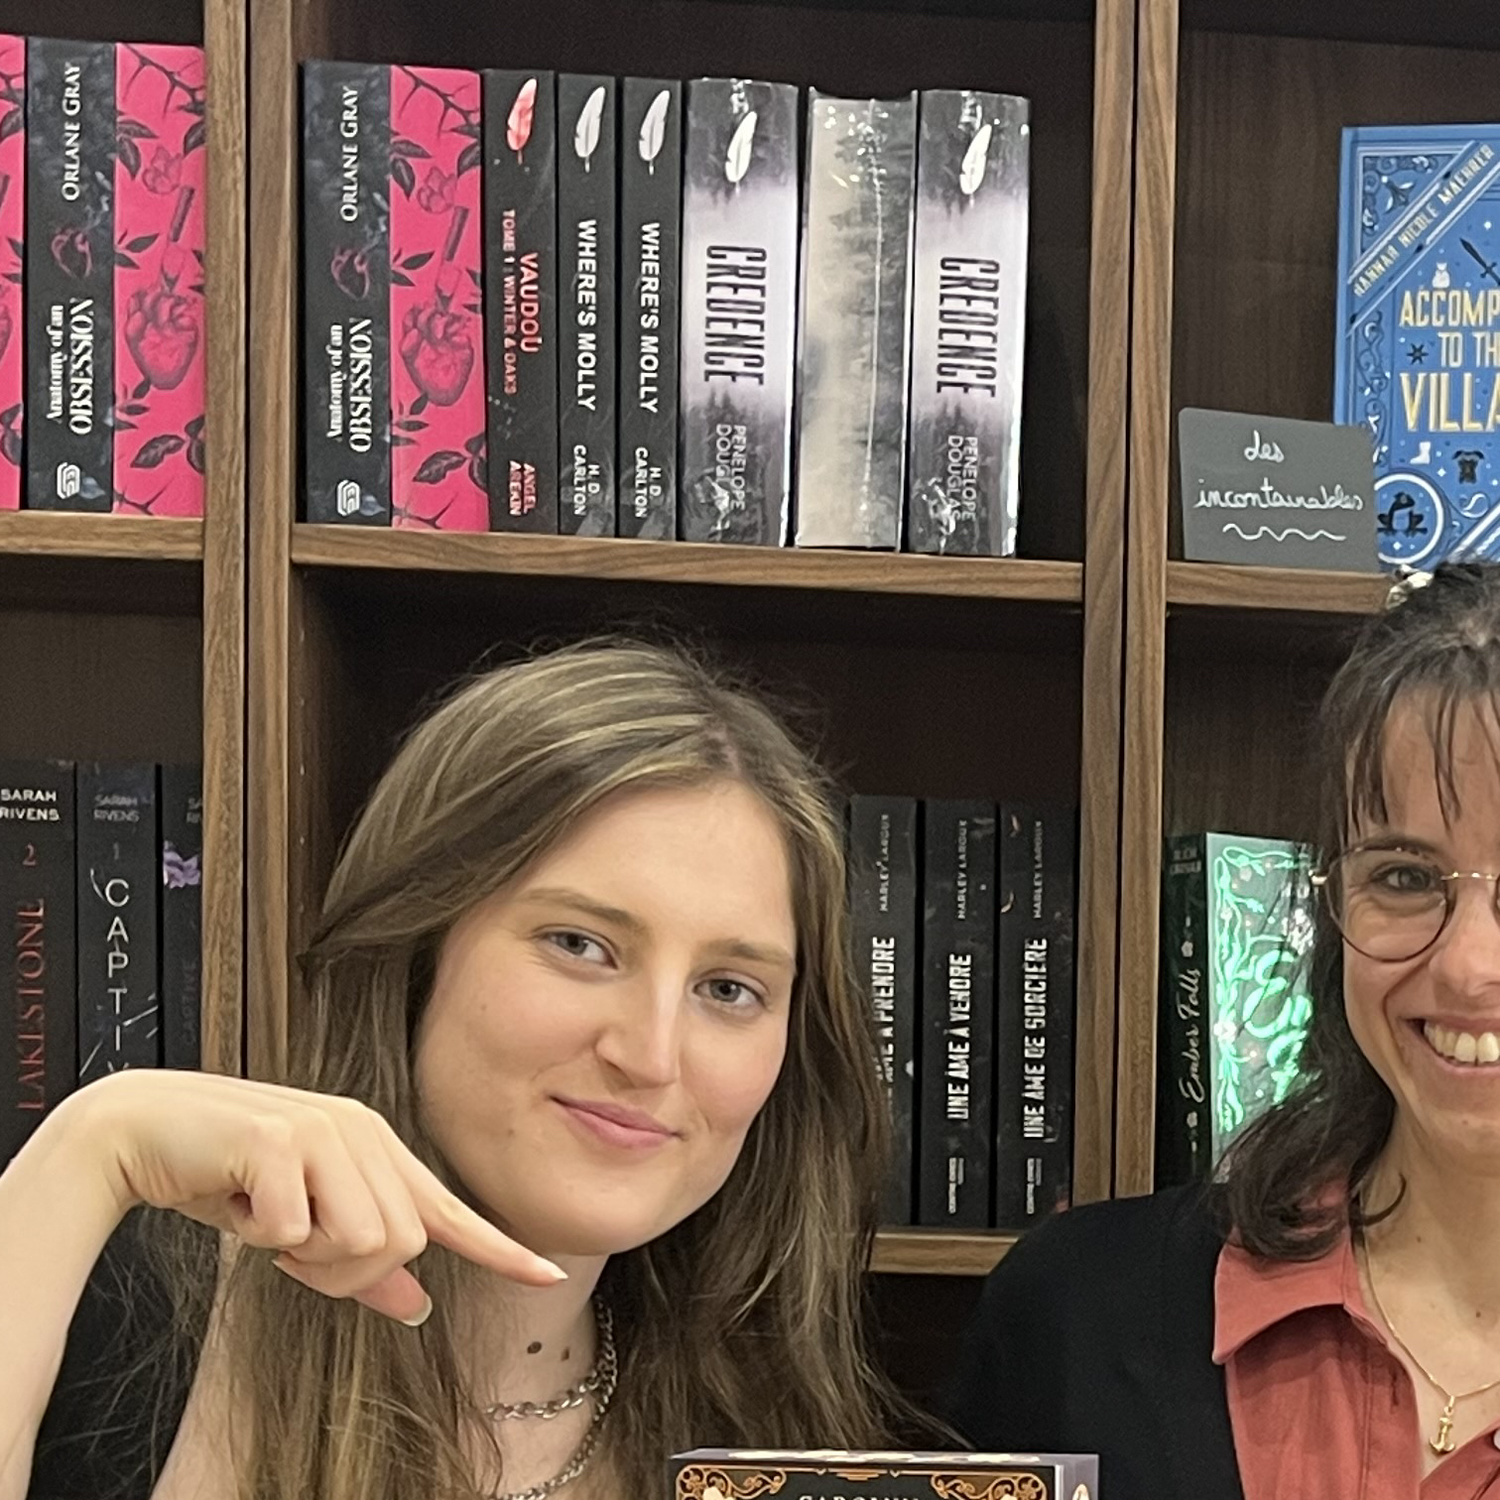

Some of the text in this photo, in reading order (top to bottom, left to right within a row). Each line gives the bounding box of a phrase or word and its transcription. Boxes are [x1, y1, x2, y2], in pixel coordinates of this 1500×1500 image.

[62, 62, 82, 202] ORLANE GRAY
[341, 86, 360, 222] ORLANE GRAY
[503, 210, 516, 250] TOME
[1352, 246, 1401, 298] HANNAH
[1398, 205, 1439, 249] NICOLE
[503, 276, 515, 334] WINTER
[577, 220, 597, 411] WHERE'S MOLLY
[639, 222, 660, 413] WHERE'S MOLLY
[704, 245, 767, 385] CREDENCE
[936, 256, 1001, 398] CREDENCE
[46, 305, 68, 424] Anatomy of an
[69, 298, 94, 434] OBSESSION
[326, 324, 345, 442] Anatomy of an
[1438, 332, 1463, 368] TO
[349, 318, 374, 453] OBSESSION
[574, 445, 586, 515] CARLTON
[588, 465, 600, 497] H. D.
[730, 424, 747, 511] PENELOPE
[961, 436, 978, 522] PENELOPE
[1244, 430, 1285, 463] des
[508, 461, 522, 515] AREKIN
[523, 463, 536, 514] ANGEL
[634, 447, 647, 518] CARLTON
[649, 467, 661, 499] H. D.
[0, 806, 60, 822] RIVENS
[1, 788, 57, 803] SARAH
[94, 794, 138, 807] SARAH
[94, 809, 140, 823] RIVENS
[24, 844, 37, 866] 2
[18, 897, 45, 1111] LAKESTONE
[104, 878, 130, 1072] CAPTI
[949, 953, 971, 1022] VENDRE
[1024, 1036, 1046, 1059] DE
[1175, 968, 1205, 1103] Ember Falls
[947, 1083, 970, 1120] UNE
[1024, 1105, 1047, 1138] UNE
